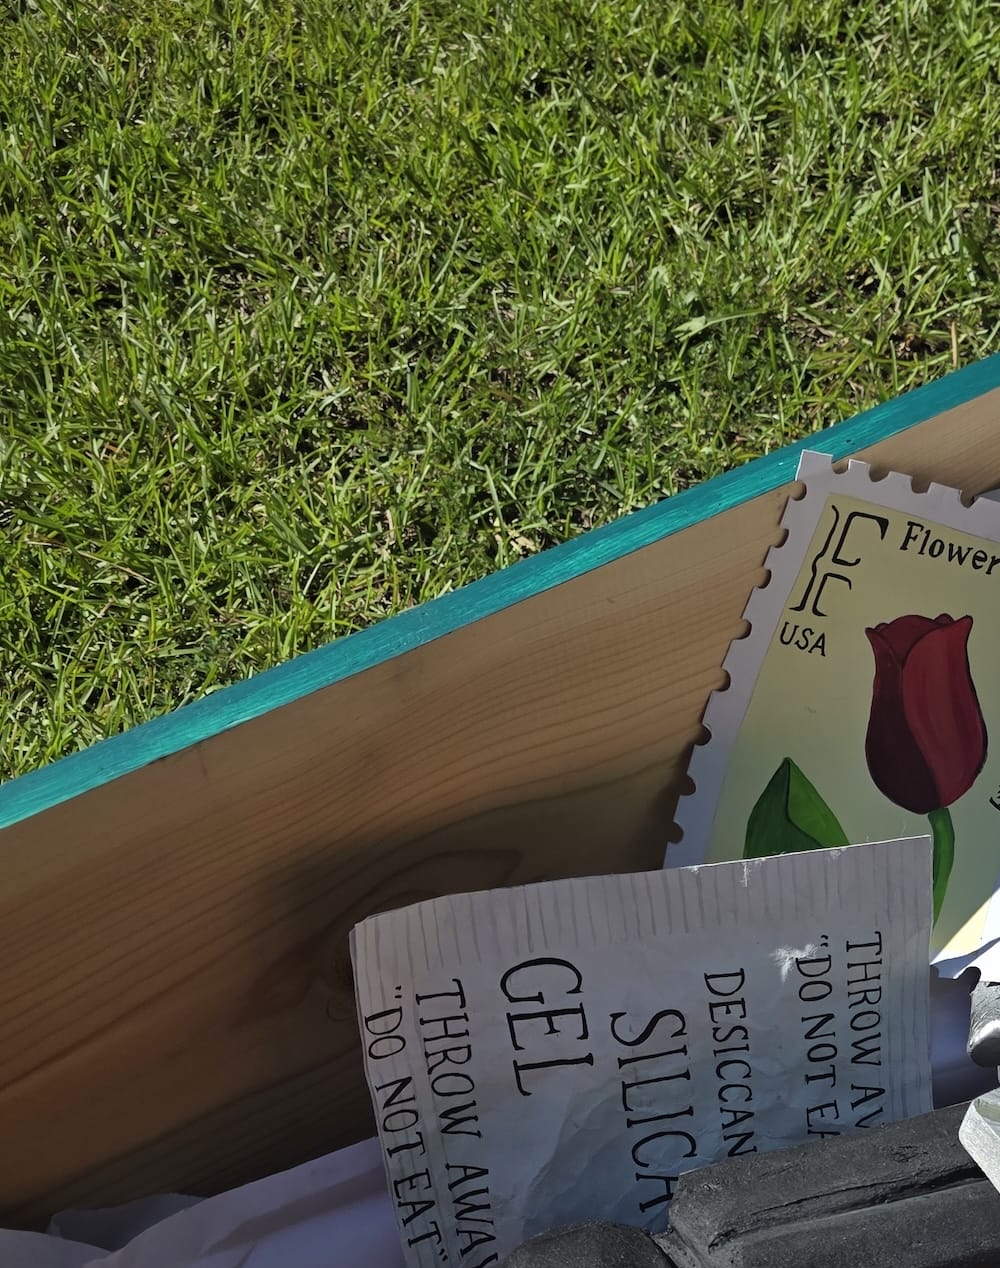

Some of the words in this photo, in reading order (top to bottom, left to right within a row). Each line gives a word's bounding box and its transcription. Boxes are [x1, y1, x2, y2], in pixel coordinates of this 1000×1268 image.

[778, 620, 828, 658] USA
[414, 977, 483, 1141] THROW
[500, 955, 595, 1097] GEL
[799, 1012, 839, 1090] NOT
[844, 930, 884, 1068] THROW
[374, 1076, 428, 1159] NOT
[609, 1008, 699, 1215] SILICA
